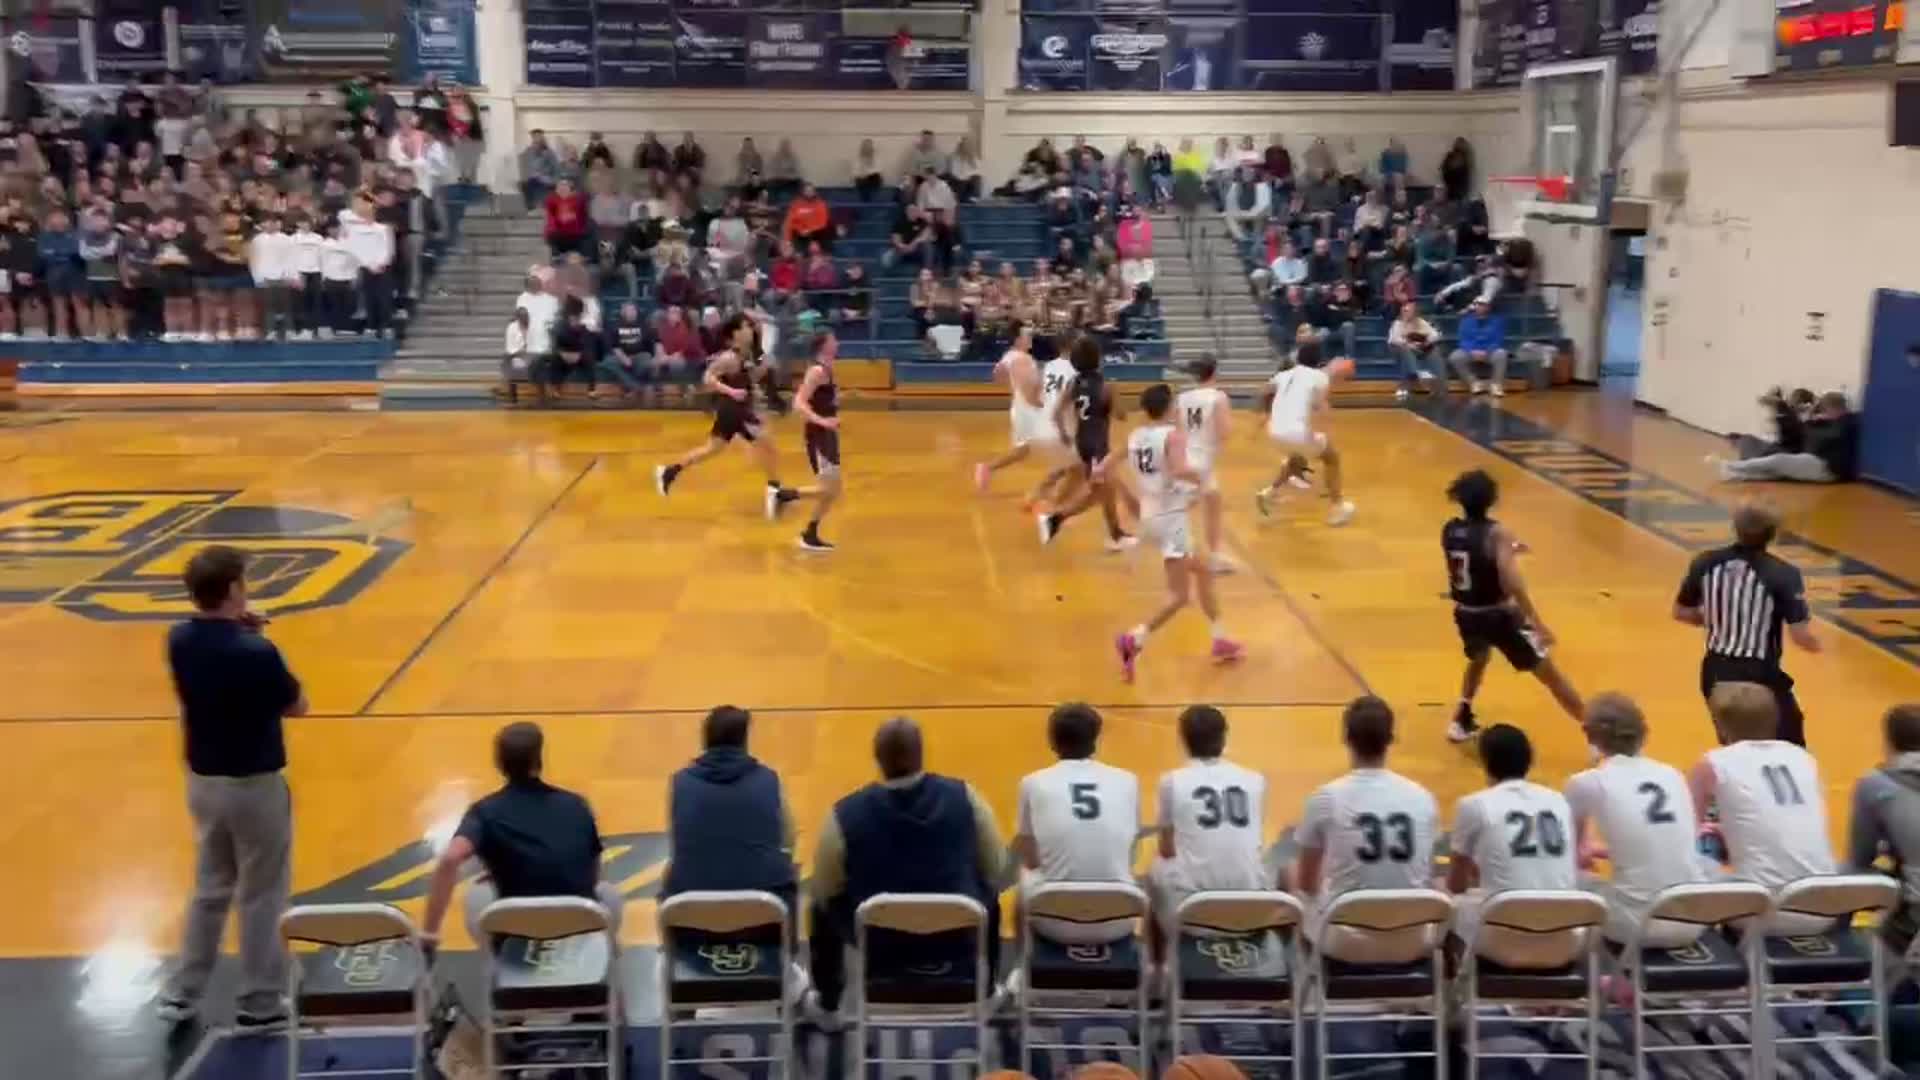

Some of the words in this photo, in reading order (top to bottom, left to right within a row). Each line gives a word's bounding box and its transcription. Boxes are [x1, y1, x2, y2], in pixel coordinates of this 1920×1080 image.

[1078, 395, 1090, 420] 2
[1137, 448, 1158, 474] 12
[1448, 550, 1472, 592] 3
[1069, 783, 1101, 820] 5
[1638, 782, 1675, 824] 2
[1762, 764, 1804, 805] 11
[1192, 786, 1250, 828] 30
[1356, 812, 1413, 863] 33
[1506, 810, 1565, 857] 20
